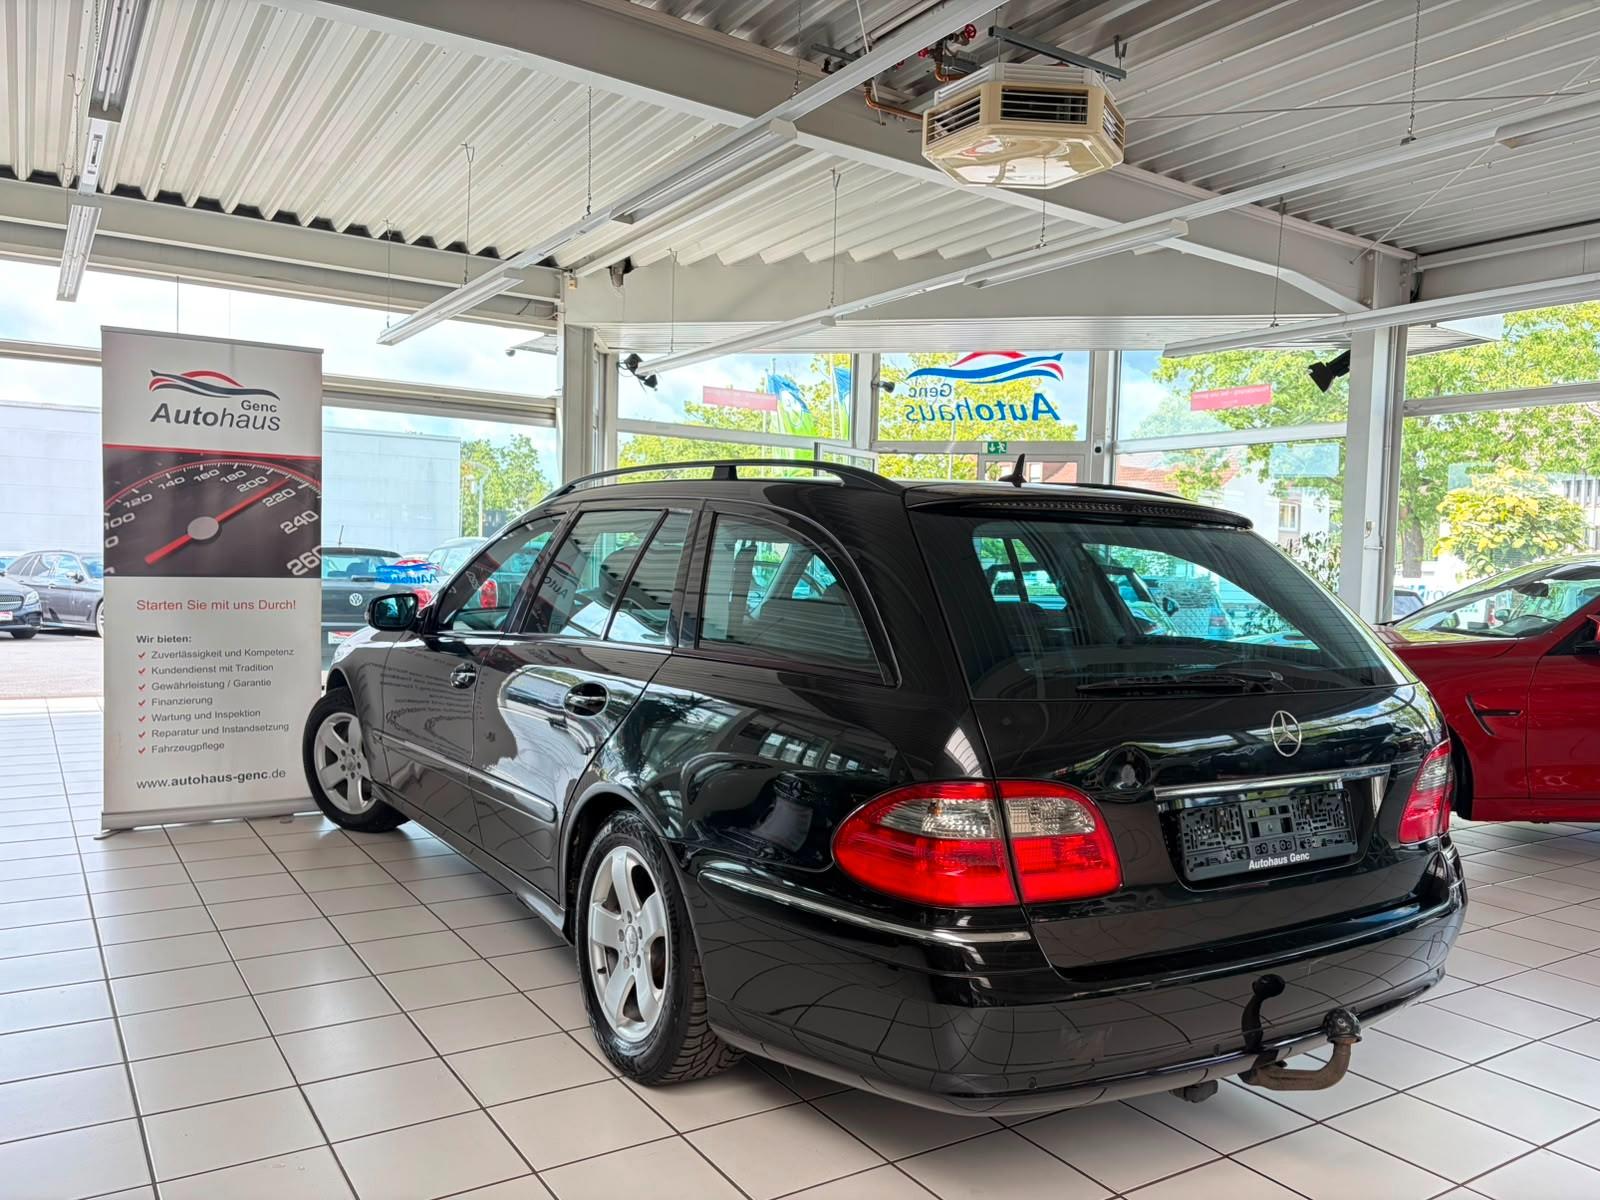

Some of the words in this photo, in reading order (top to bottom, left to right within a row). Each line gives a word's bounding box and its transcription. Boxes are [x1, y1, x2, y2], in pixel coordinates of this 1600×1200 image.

[241, 399, 278, 413] Genc
[150, 402, 281, 431] Autohaus
[158, 476, 185, 490] 140
[193, 469, 220, 483] 160
[219, 469, 247, 484] 180
[236, 475, 269, 493] 200
[123, 493, 153, 509] 120
[262, 488, 296, 508] 220
[280, 510, 319, 534] 240
[136, 600, 183, 611] Starten
[187, 600, 207, 610] Sie
[211, 600, 230, 610] mit
[233, 600, 255, 610] uns
[258, 600, 297, 610] Durch!
[136, 635, 154, 643] Wir
[157, 635, 192, 643] bieten:
[151, 650, 222, 661] Zuverlässigkeit
[225, 649, 242, 657] und
[244, 648, 295, 658] Kompetenz
[151, 666, 217, 675] Kundendienst
[219, 664, 233, 673] mit
[235, 664, 273, 672] Tradition
[151, 680, 225, 691] Gewährleistung
[233, 678, 272, 688] Garantie
[151, 696, 213, 706] Finanzierung
[151, 712, 192, 722] Wartung
[194, 711, 212, 720] und
[214, 709, 261, 719] Inspektion
[151, 727, 199, 738] Reparatur
[201, 726, 219, 735] und
[222, 723, 290, 734] Instandsetzung
[151, 742, 225, 754] Fahrzeugpflege
[136, 769, 287, 789] www.autohaus-genc.de
[1248, 855, 1288, 870] Autohaus
[1290, 852, 1310, 863] Genc
